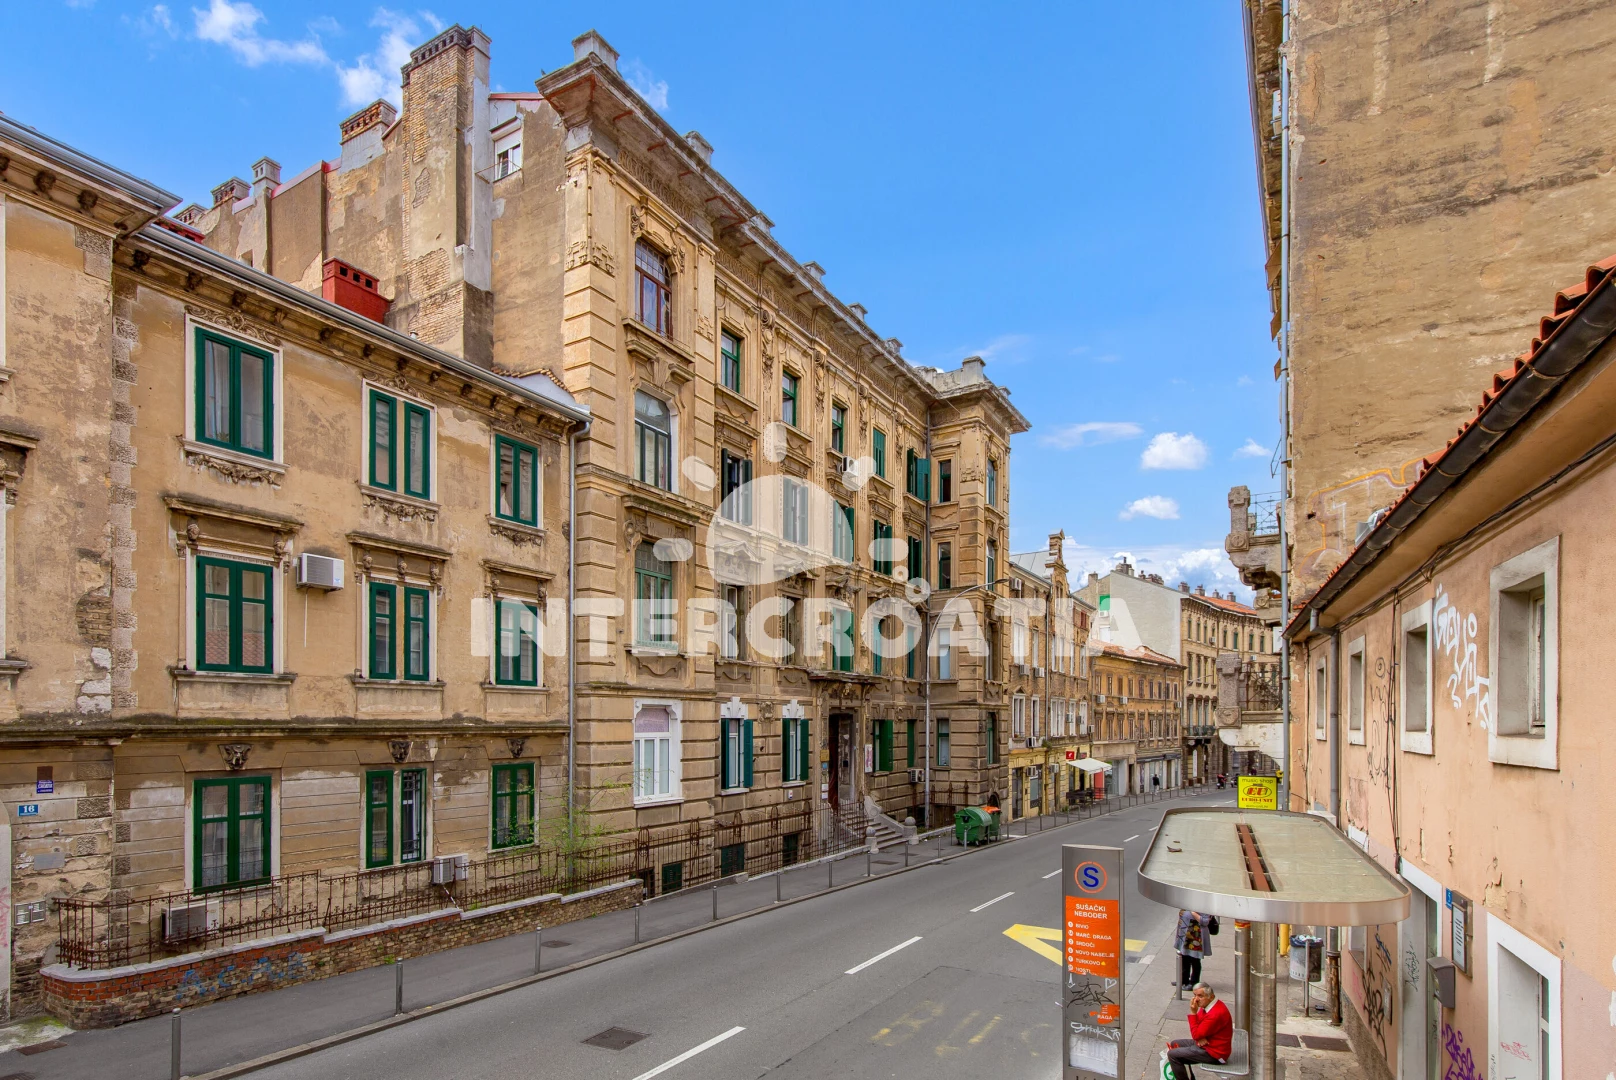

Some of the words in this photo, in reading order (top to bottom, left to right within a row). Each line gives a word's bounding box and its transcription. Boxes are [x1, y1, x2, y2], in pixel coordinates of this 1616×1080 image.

[23, 805, 35, 813] 16
[1083, 866, 1099, 888] S
[1075, 903, 1106, 912] SUŠAČKI
[1074, 911, 1107, 920] NEBODER
